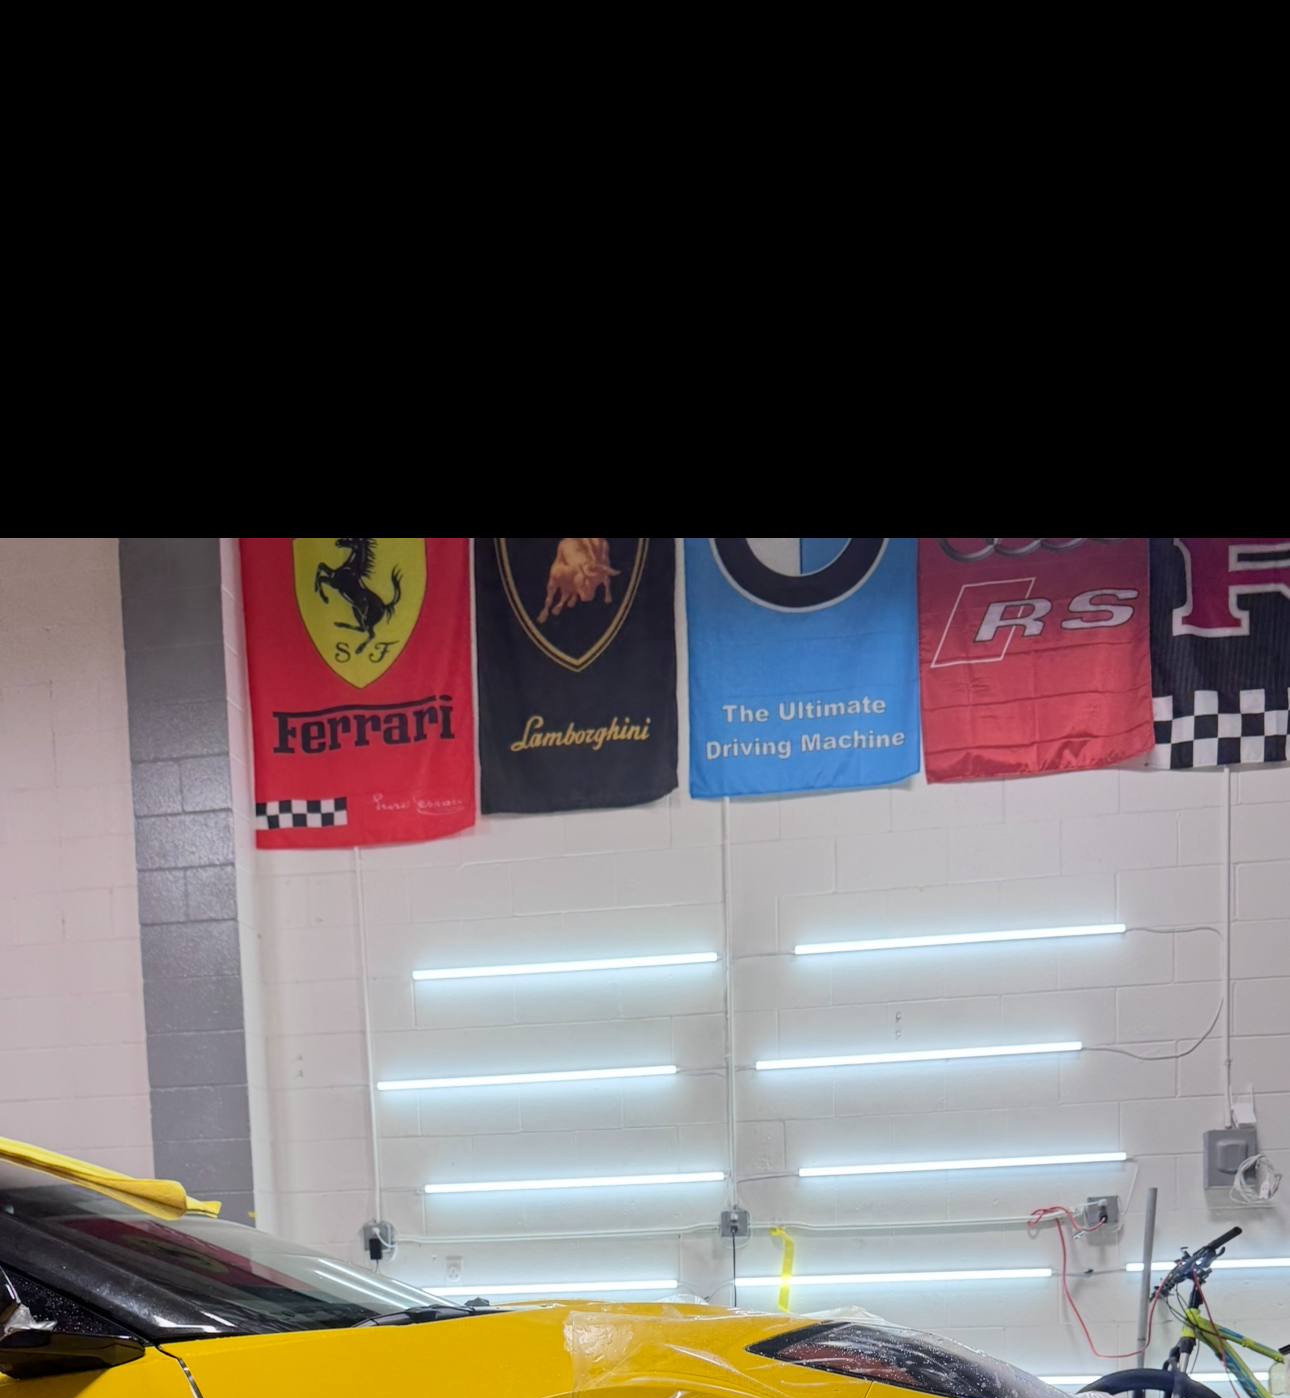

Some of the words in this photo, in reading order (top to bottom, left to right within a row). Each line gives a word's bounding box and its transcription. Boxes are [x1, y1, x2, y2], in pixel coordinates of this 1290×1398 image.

[972, 588, 1139, 643] RS
[334, 642, 351, 663] S
[272, 694, 455, 754] Ferrari
[722, 704, 769, 723] The
[778, 697, 886, 721] Ultimate
[510, 715, 652, 752] Lamborghini
[706, 738, 791, 760] Driving
[801, 730, 905, 752] Machine
